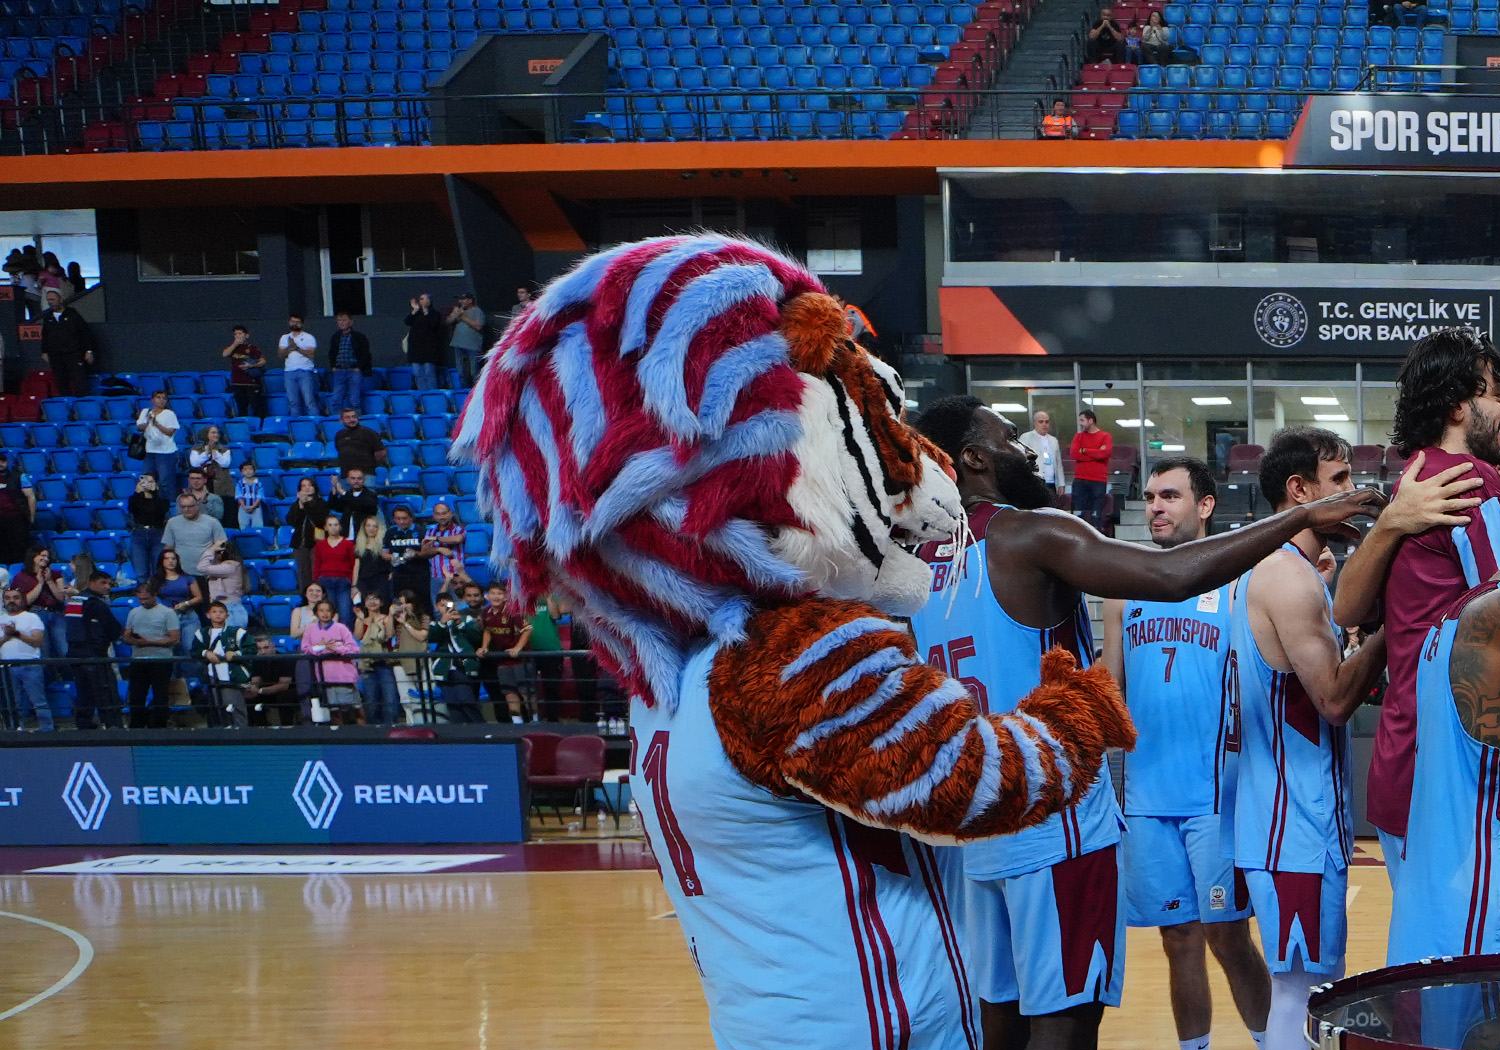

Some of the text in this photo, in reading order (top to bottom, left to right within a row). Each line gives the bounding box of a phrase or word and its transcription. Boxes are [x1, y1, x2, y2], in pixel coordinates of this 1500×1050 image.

[1329, 110, 1420, 152] SPOR
[1318, 302, 1354, 319] T.C.
[1360, 298, 1450, 323] GENÇLİK
[1454, 303, 1481, 320] VE
[1318, 325, 1378, 341] SPOR
[391, 538, 420, 547] VESTEL
[1125, 617, 1221, 653] TRABZONSPOR
[1161, 647, 1177, 683] 7
[121, 785, 254, 805] RENAULT
[354, 784, 489, 804] RENAULT
